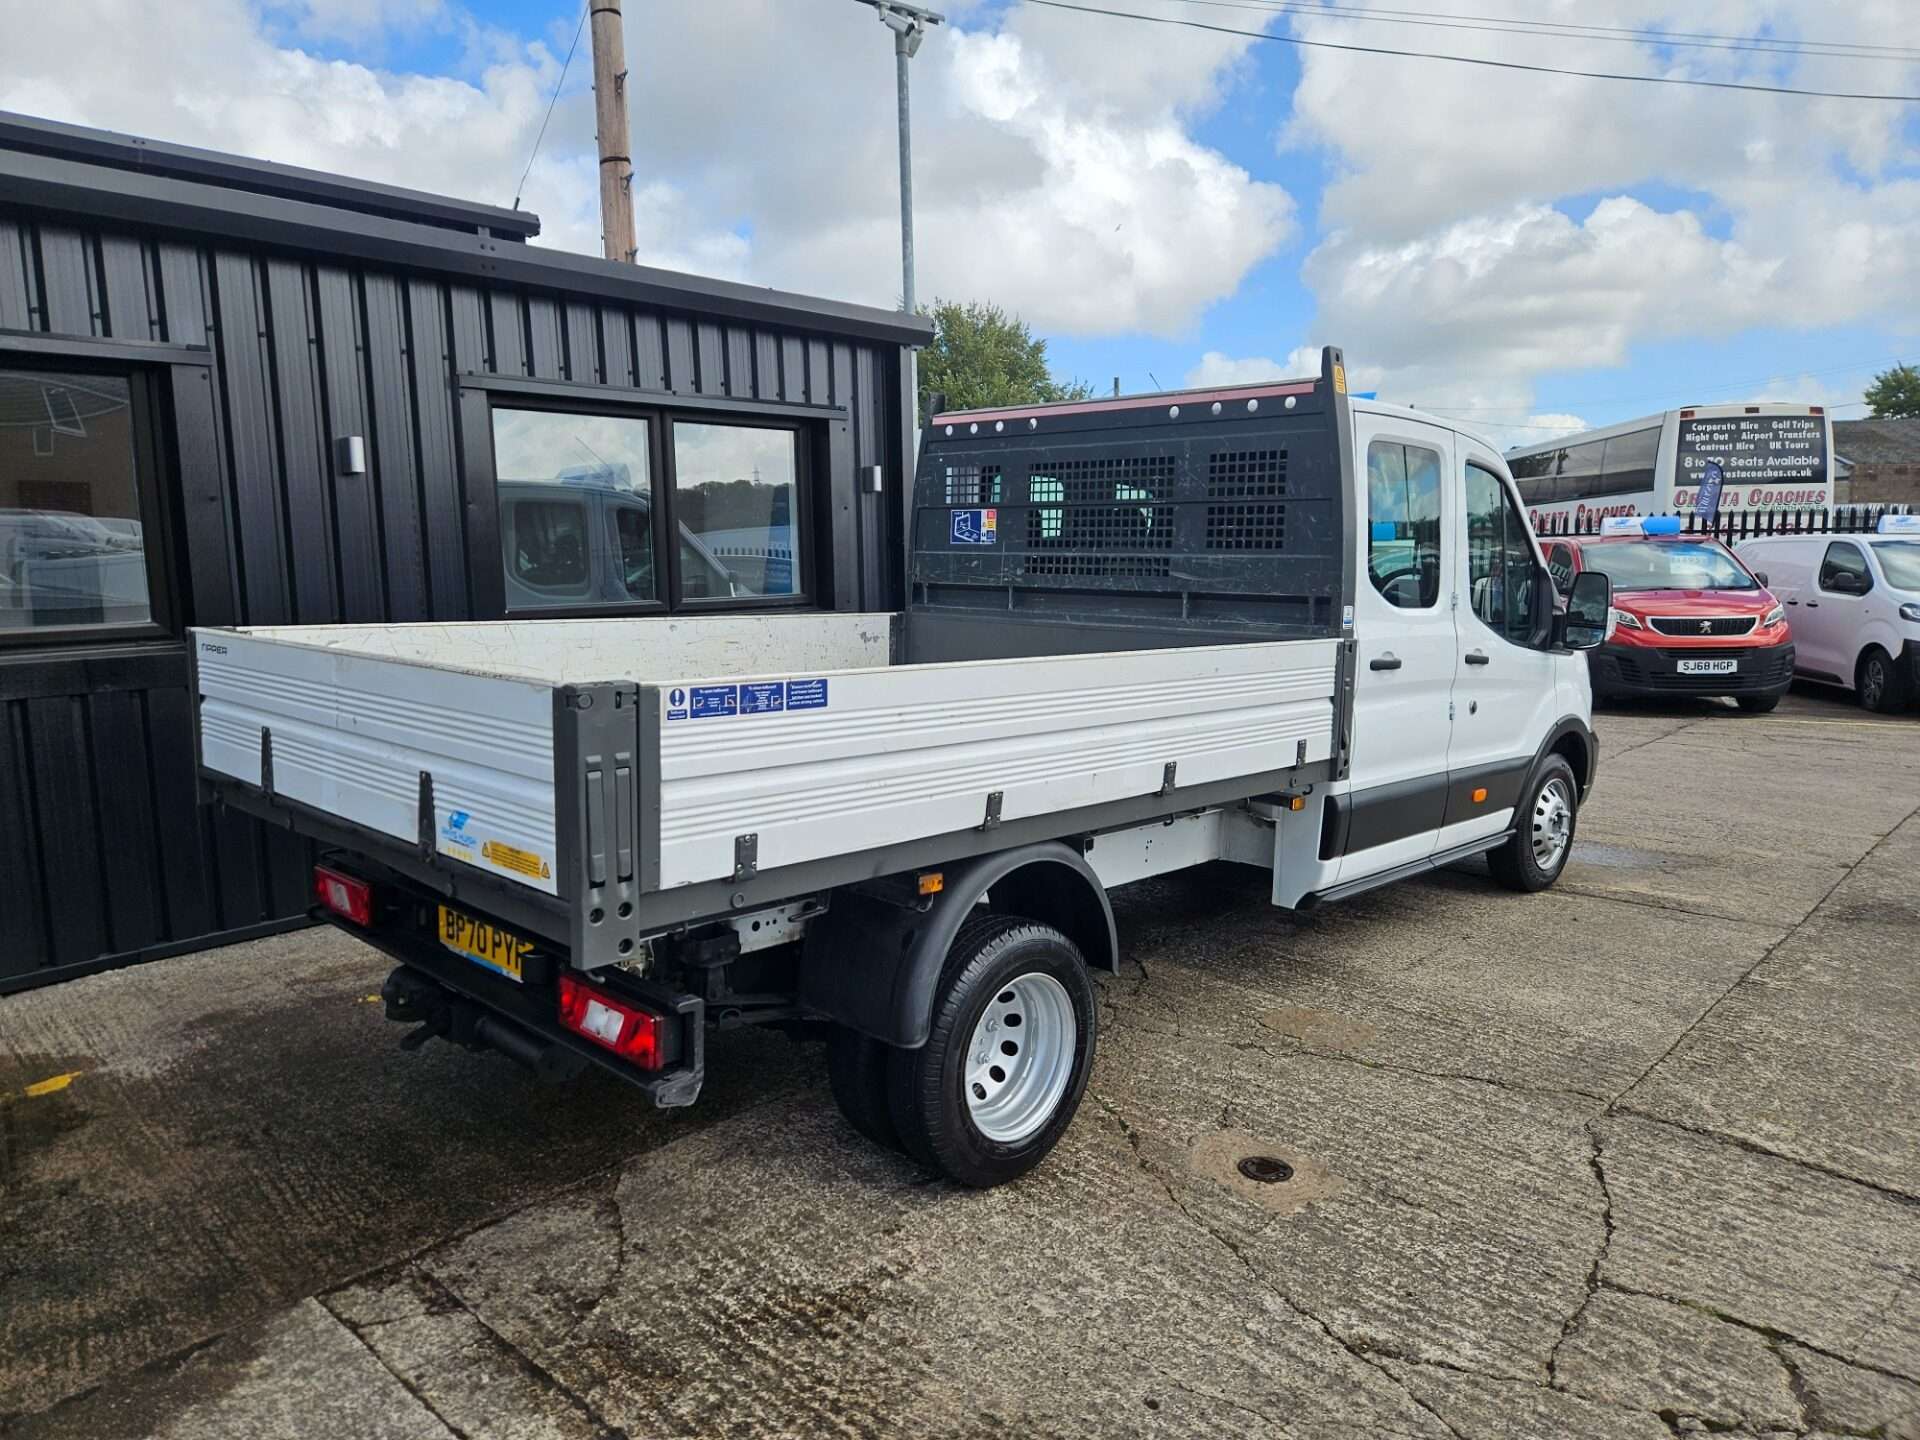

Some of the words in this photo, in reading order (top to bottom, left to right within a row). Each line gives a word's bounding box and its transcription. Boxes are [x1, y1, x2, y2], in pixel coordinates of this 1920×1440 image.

[1692, 422, 1736, 432] Corporate
[1740, 421, 1759, 430] Hire
[1771, 420, 1790, 429] Golf
[1792, 419, 1814, 430] Trips
[1686, 432, 1709, 442] Night
[1713, 432, 1729, 441] Out
[1741, 431, 1773, 441] Airport
[1778, 430, 1820, 439] Transfers
[1695, 443, 1733, 451] Contract
[1736, 441, 1754, 450] Hire
[1770, 441, 1781, 450] UK
[1784, 440, 1809, 449] Tours
[1684, 456, 1693, 468] 8
[1695, 458, 1705, 467] to
[1730, 456, 1764, 467] Seats
[1766, 455, 1820, 466] Available
[1690, 467, 1812, 479] wwestacoaches.co.uk
[1673, 489, 1740, 507] CRTA
[1748, 487, 1826, 506] COACHES
[1682, 661, 1711, 671] SJ68
[1713, 661, 1733, 671] HGP
[446, 909, 487, 954] BP70
